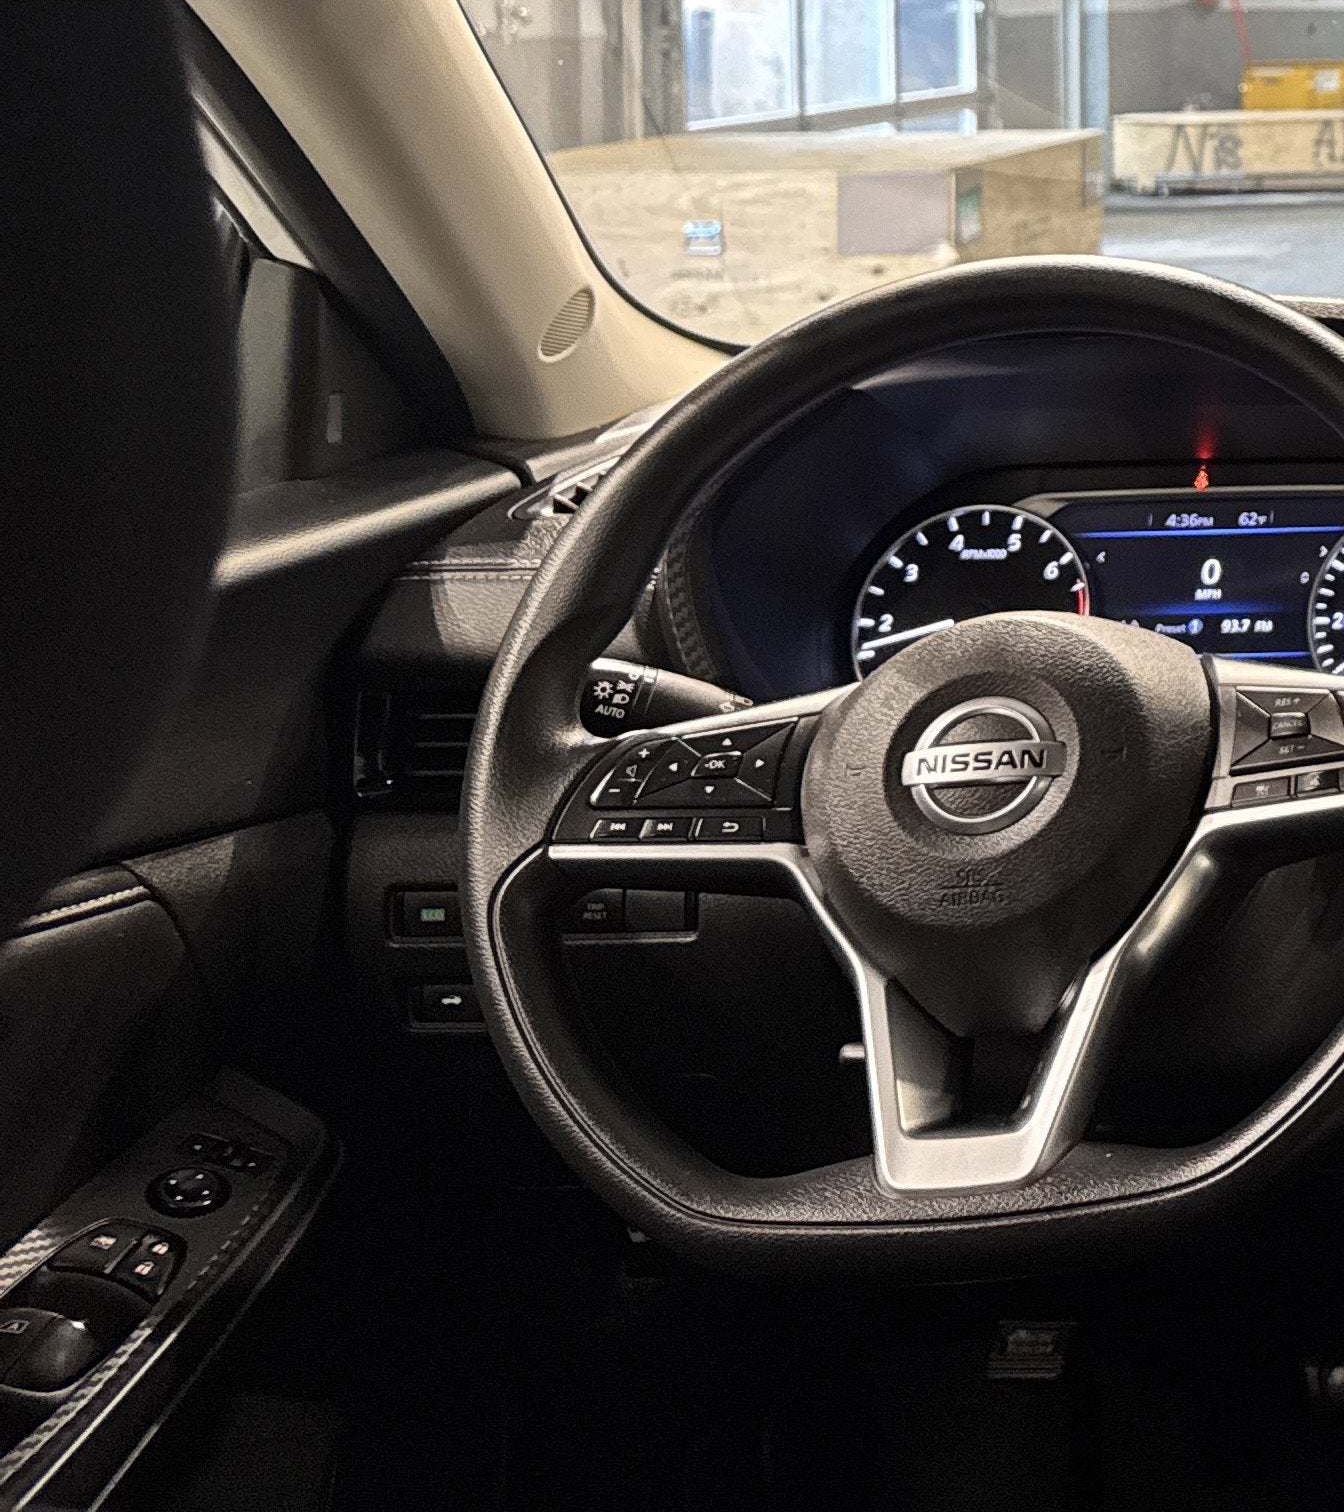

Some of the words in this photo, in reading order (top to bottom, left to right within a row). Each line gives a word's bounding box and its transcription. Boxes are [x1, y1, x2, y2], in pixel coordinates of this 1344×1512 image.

[948, 533, 965, 552] 4
[1006, 533, 1022, 552] 5
[903, 563, 919, 583] 3
[1042, 560, 1059, 580] 6
[1201, 558, 1221, 586] 0
[1194, 588, 1222, 600] MPH
[878, 614, 894, 633] 2
[1220, 619, 1251, 634] 93.7
[594, 704, 626, 719] AUTO
[917, 748, 1048, 776] NISSAN
